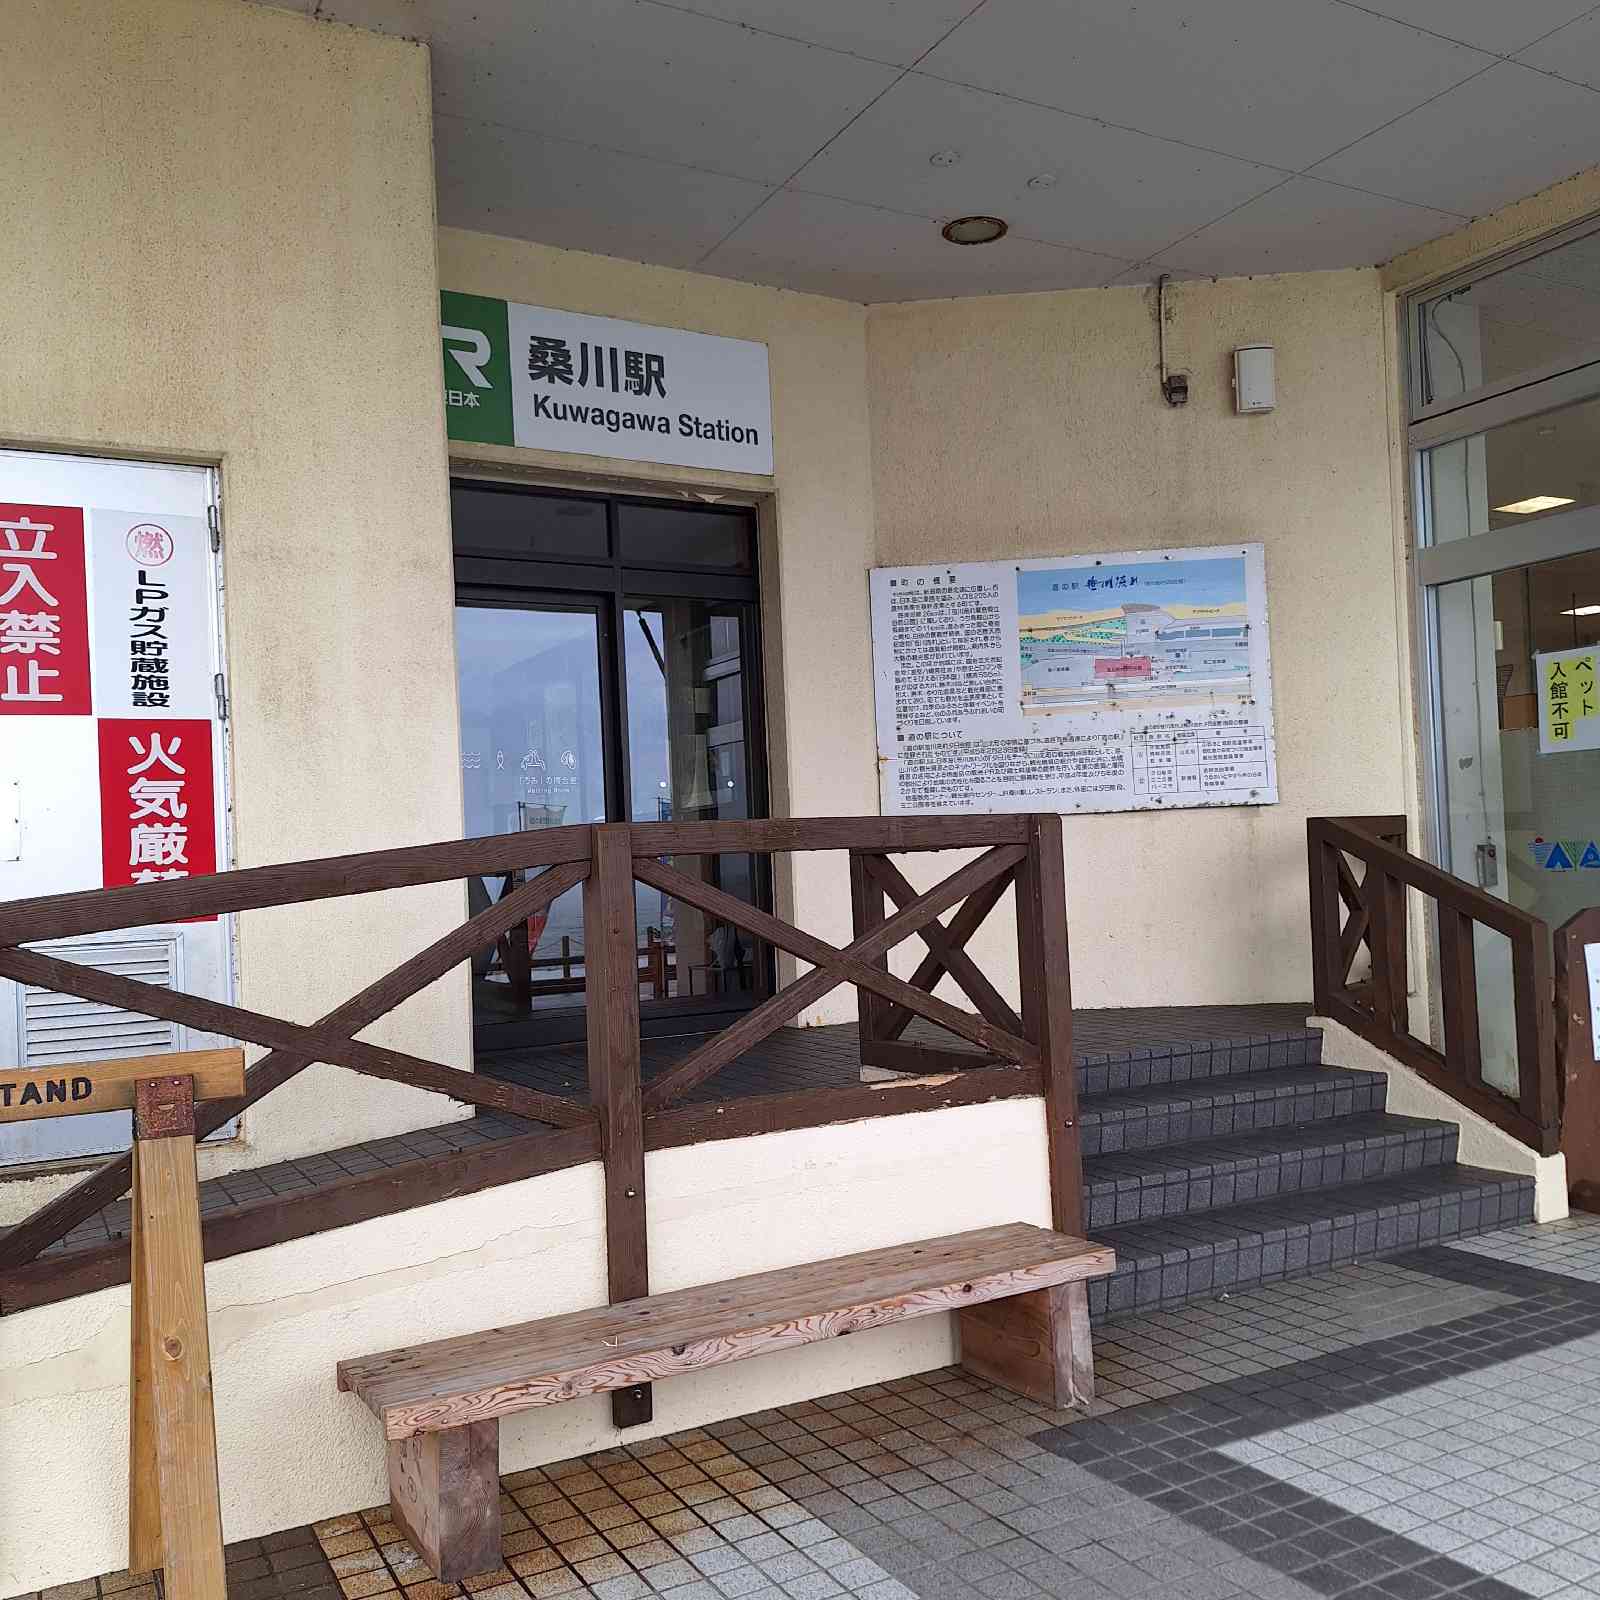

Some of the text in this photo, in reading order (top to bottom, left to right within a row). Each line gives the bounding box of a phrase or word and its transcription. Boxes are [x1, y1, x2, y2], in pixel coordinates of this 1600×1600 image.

[528, 336, 667, 399] 桑川駅
[444, 390, 480, 408] 日本
[533, 393, 759, 446] Kuwagawa Station
[0, 516, 63, 702] 立入禁止
[129, 569, 170, 708] LPガス貯蔵施設
[1550, 662, 1570, 739] 入館不可
[1575, 656, 1595, 716] ペット
[0, 1077, 92, 1107] TAND
